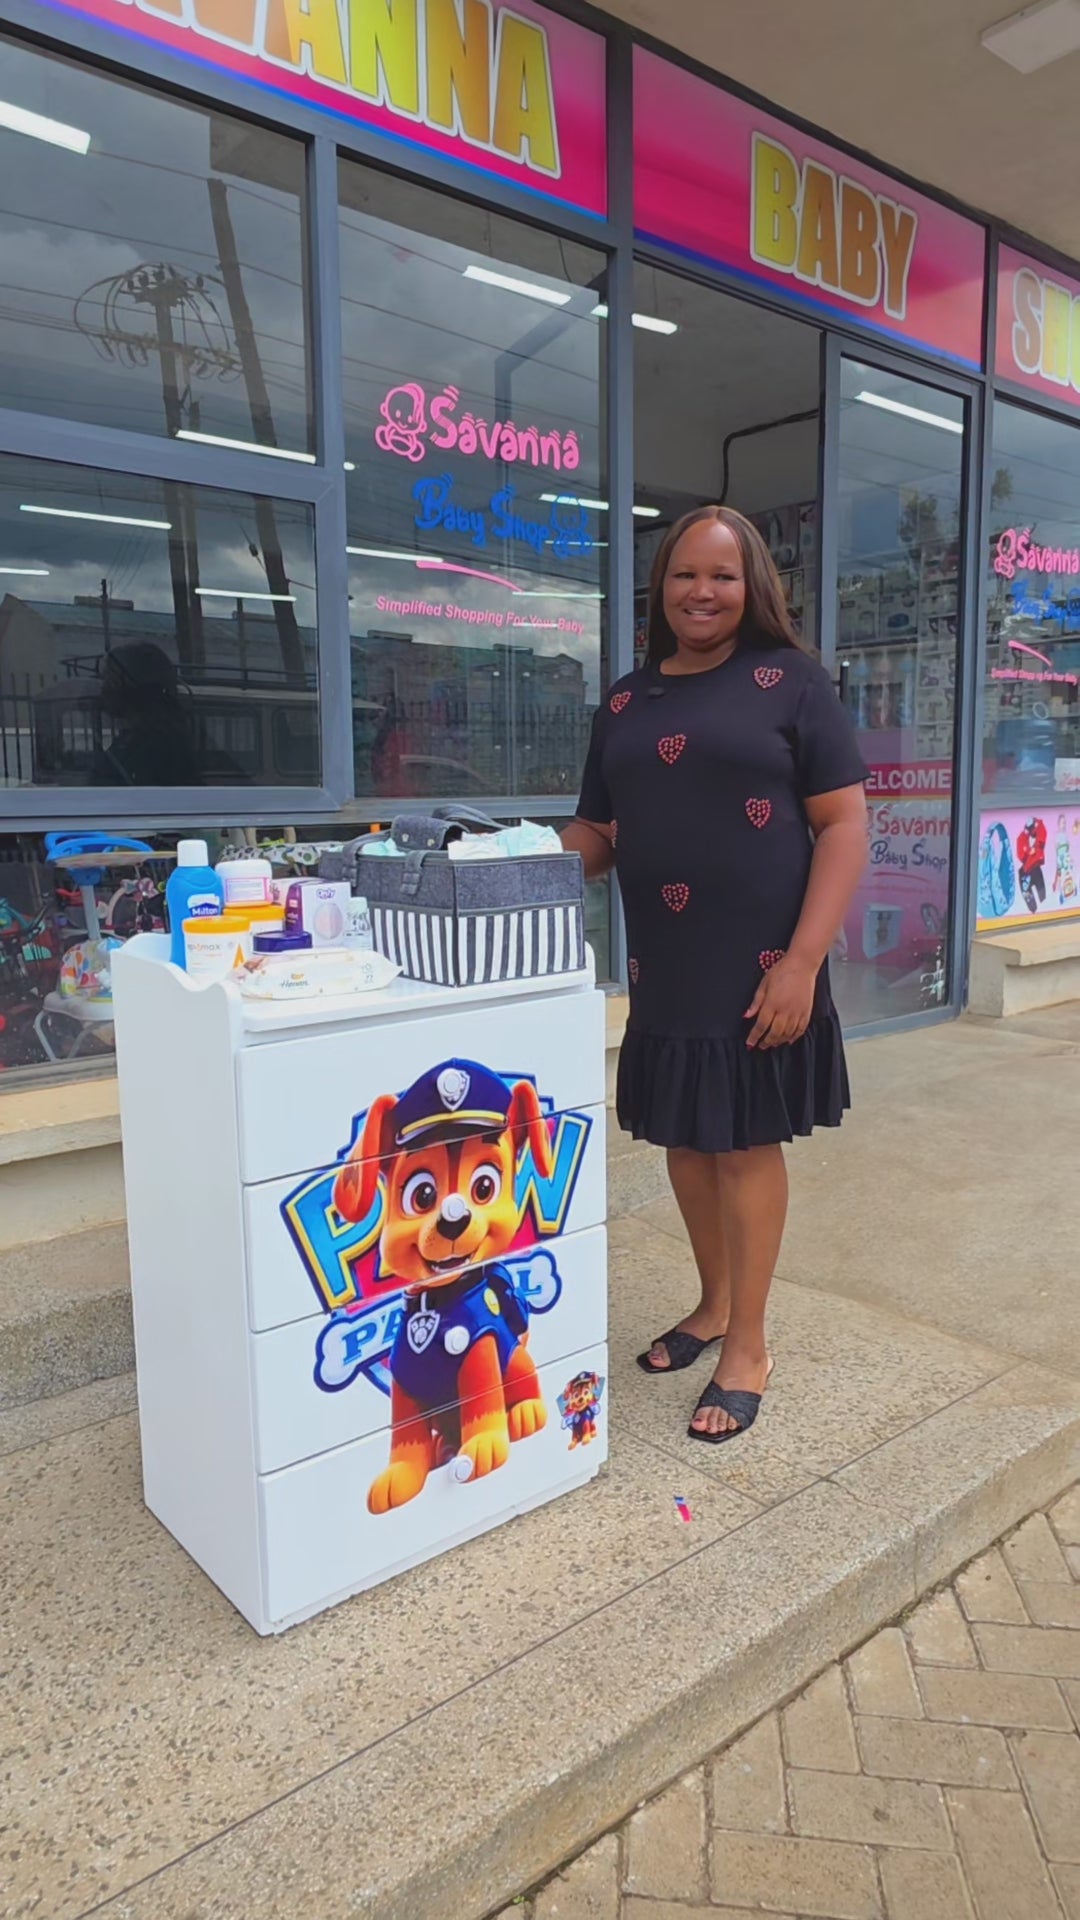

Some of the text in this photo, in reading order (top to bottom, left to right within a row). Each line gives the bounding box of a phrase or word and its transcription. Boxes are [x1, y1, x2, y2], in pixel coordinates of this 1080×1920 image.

[750, 131, 918, 320] BABY
[429, 385, 580, 470] Savanna
[412, 473, 551, 555] Baby Shop
[1017, 528, 1080, 574] Savanna
[376, 595, 585, 635] Simplified Shopping For Your Baby
[865, 769, 951, 790] ELCOME
[870, 838, 948, 872] Baby Shop
[191, 906, 219, 916] Milton
[280, 1112, 593, 1312] PW
